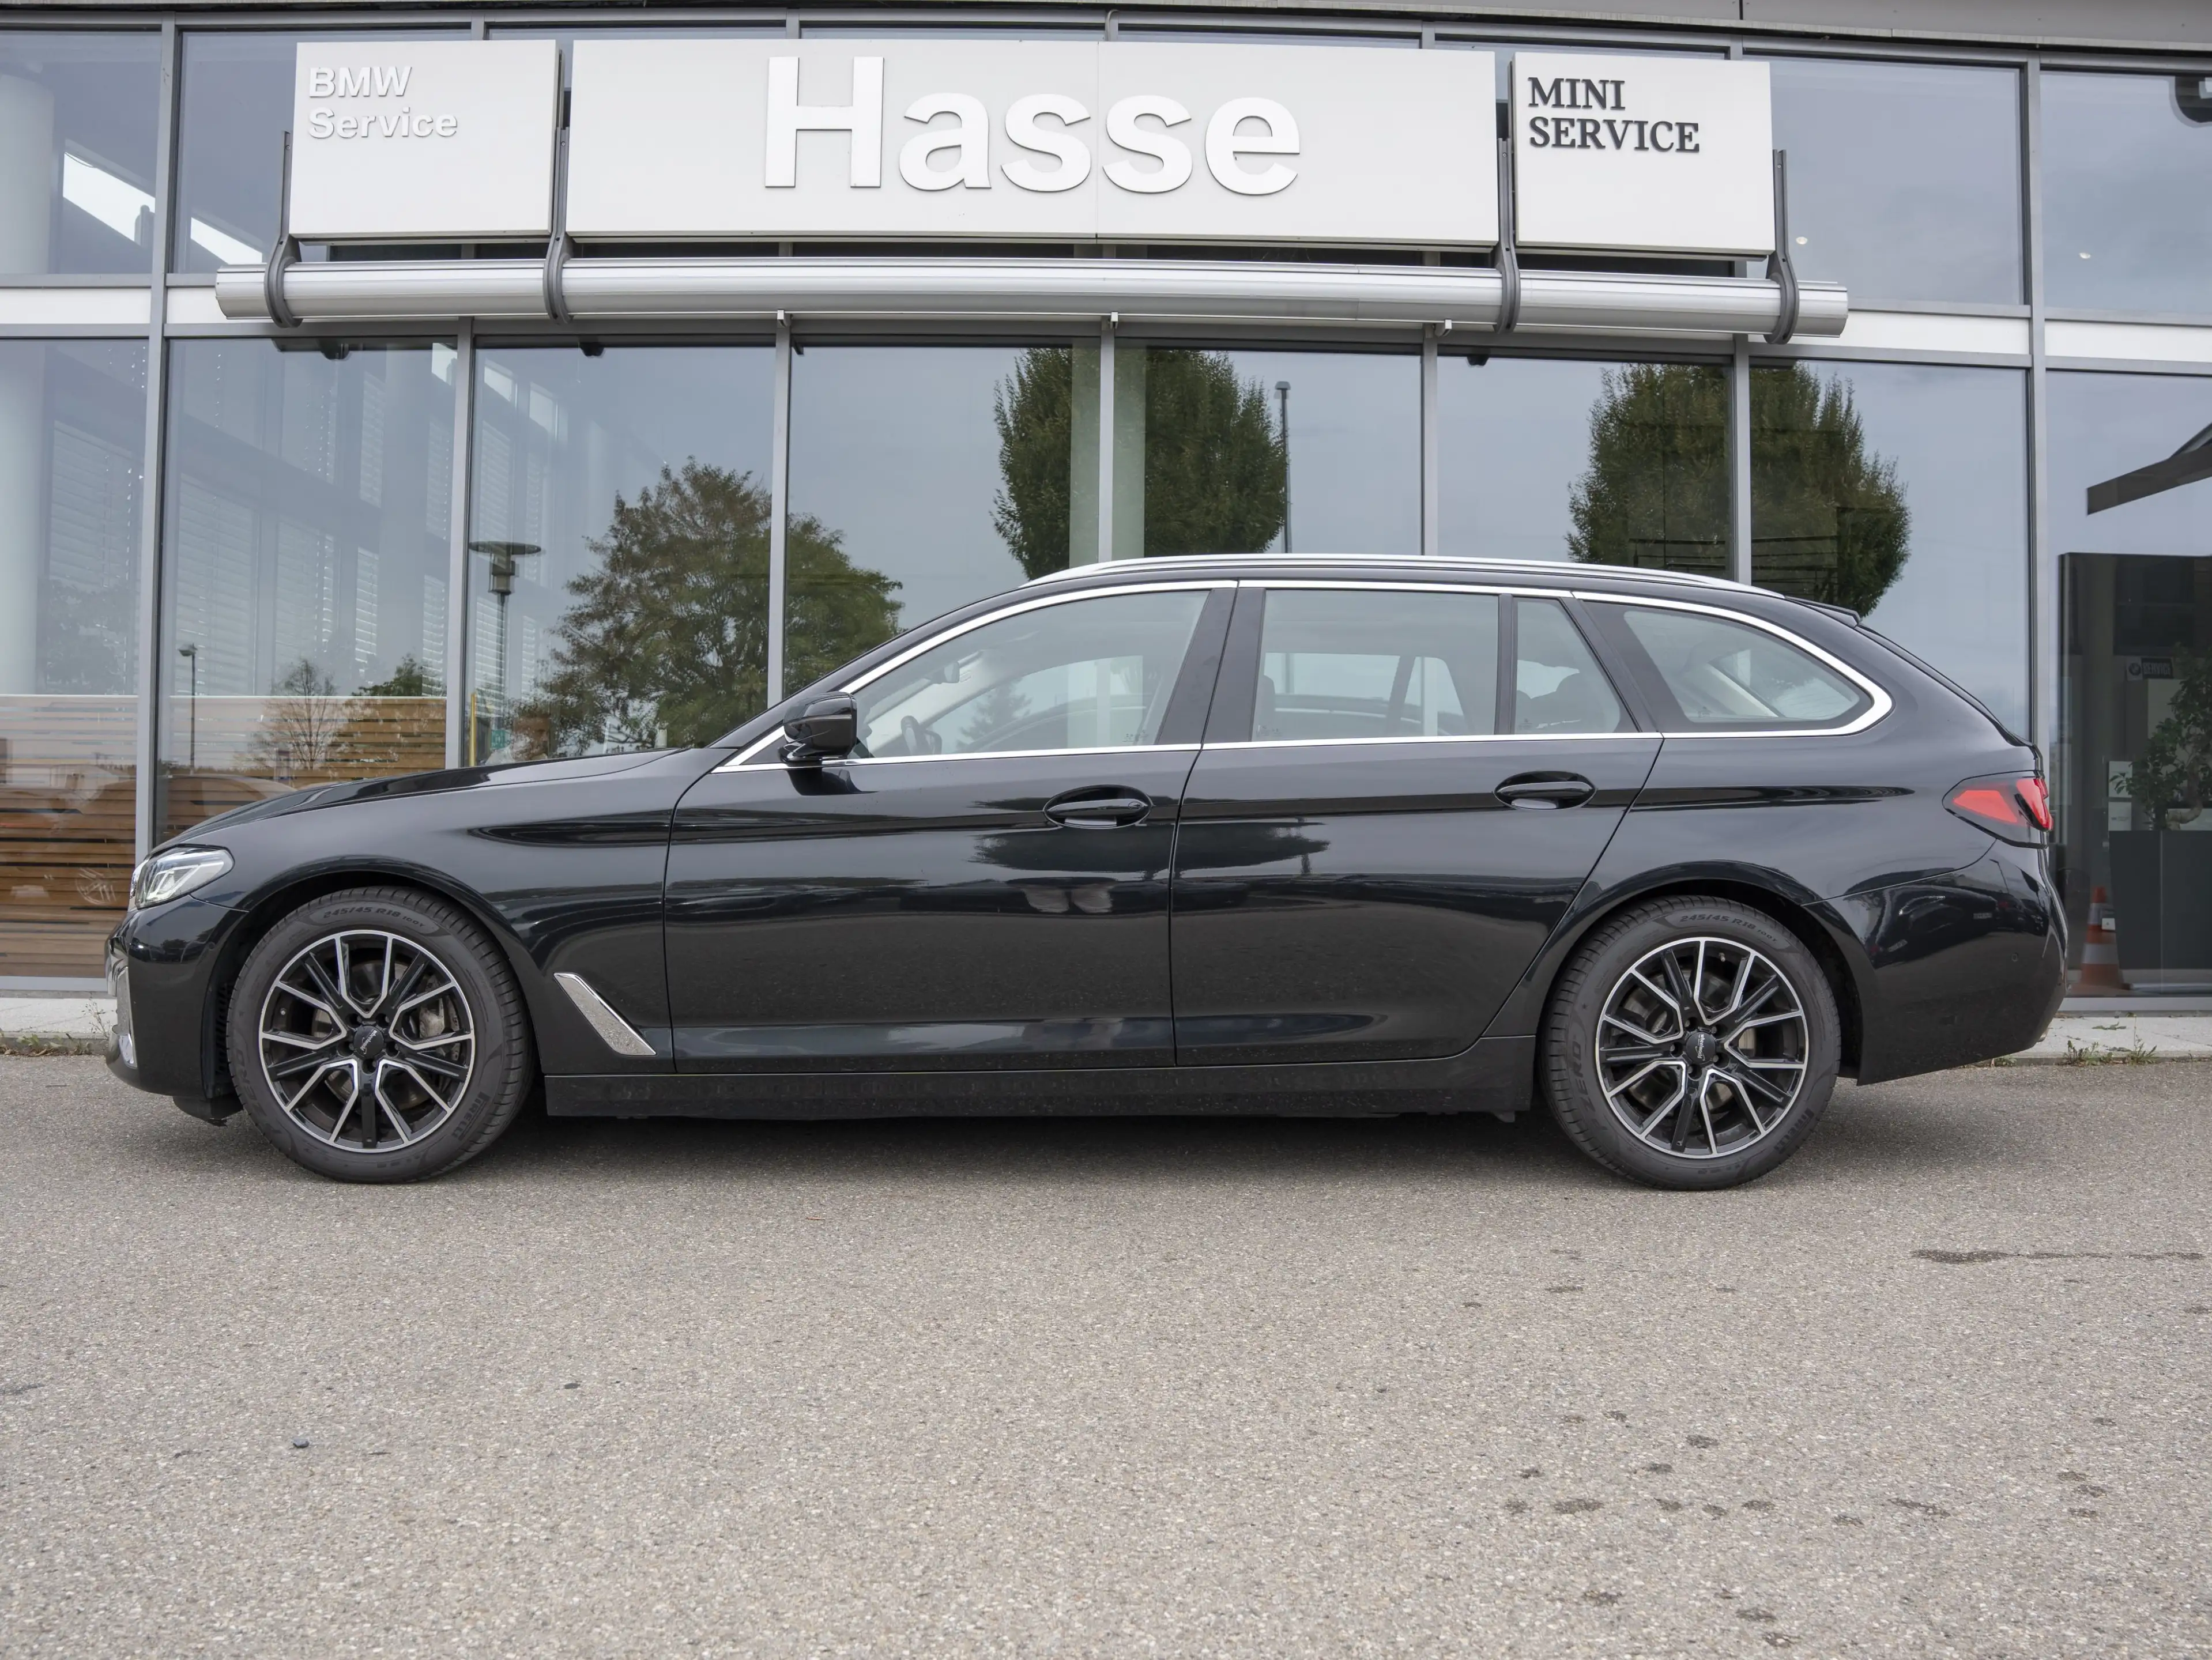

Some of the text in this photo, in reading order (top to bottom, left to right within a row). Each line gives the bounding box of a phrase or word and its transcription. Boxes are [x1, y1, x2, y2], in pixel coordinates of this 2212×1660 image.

[308, 66, 412, 98] BMW
[1528, 77, 1626, 110] MINI
[308, 107, 458, 139] Service
[765, 56, 1300, 196] Hasse
[1529, 116, 1700, 153] SERVICE
[2143, 662, 2171, 675] SERVICE
[323, 907, 427, 927] 245/45 R18 100Y
[1679, 914, 1730, 923] 245/45
[1731, 918, 1757, 930] R18
[1697, 1034, 1705, 1059] wheelworld
[1572, 1040, 1596, 1113] ZERO
